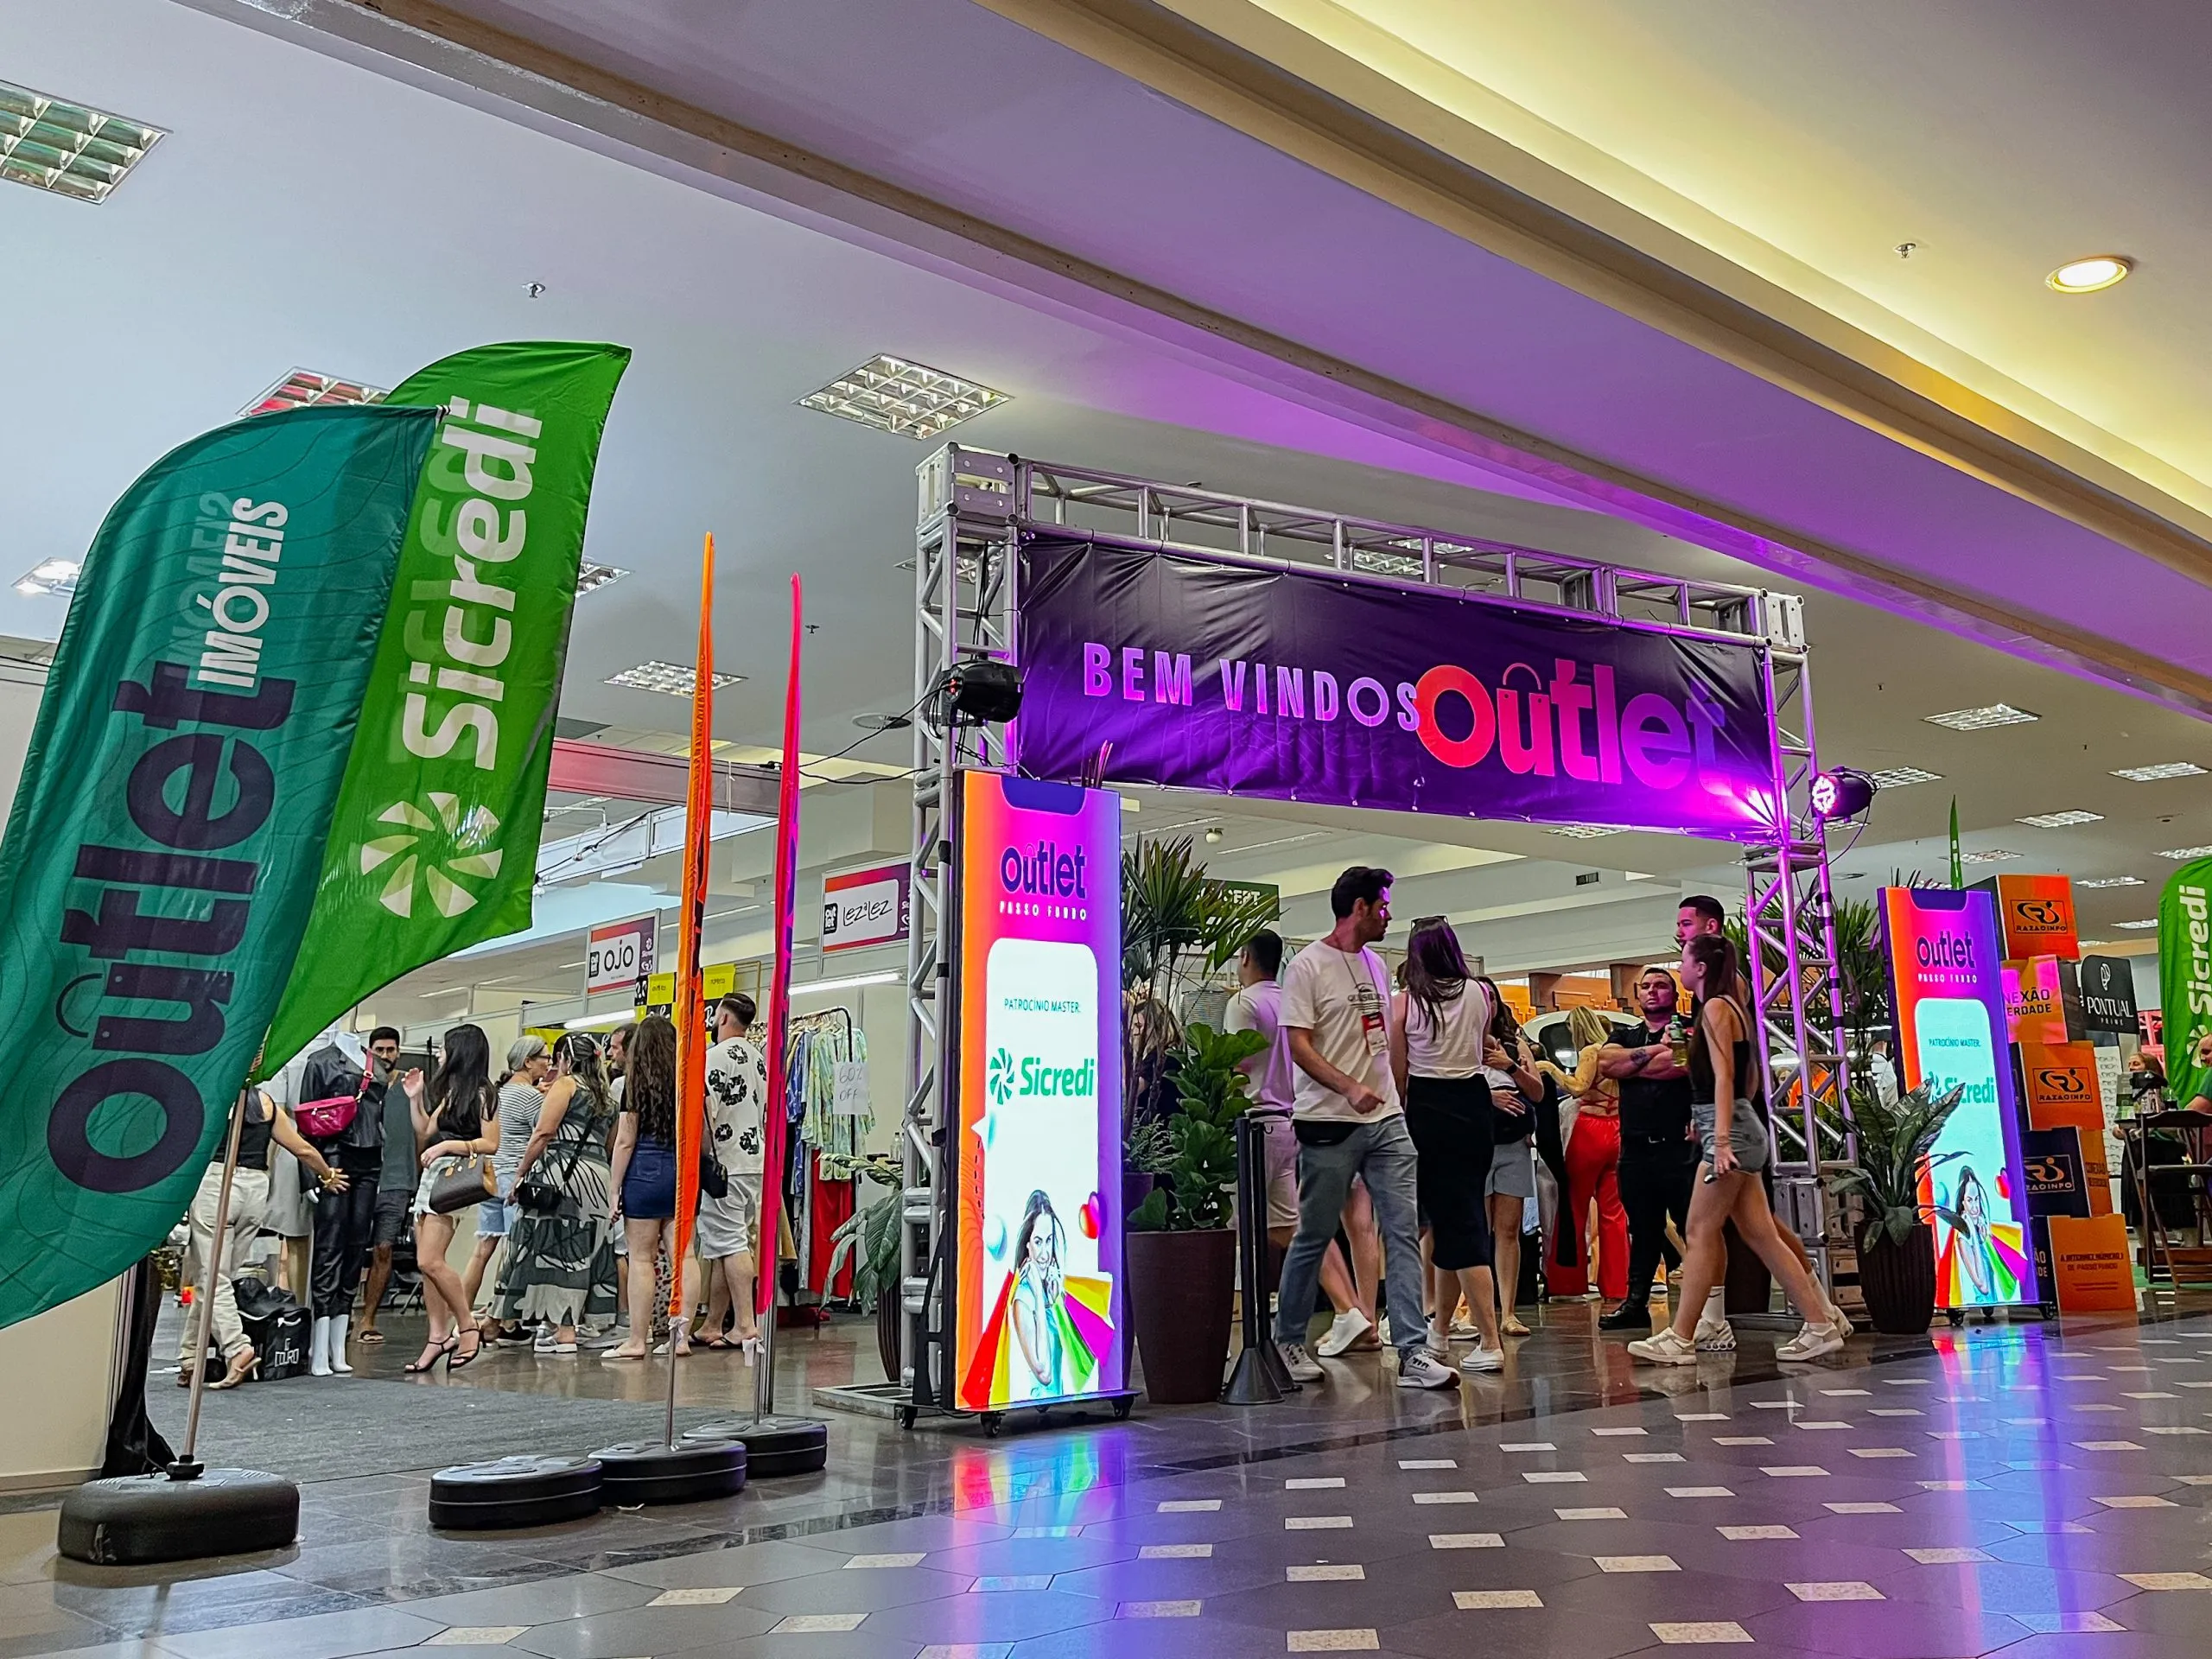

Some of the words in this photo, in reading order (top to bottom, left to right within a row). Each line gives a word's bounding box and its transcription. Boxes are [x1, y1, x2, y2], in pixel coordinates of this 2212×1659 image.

[196, 497, 289, 688] IMÓVEIS
[401, 397, 543, 772] Sicredi
[1084, 641, 1192, 706] BEM
[1218, 658, 1421, 733] VINDOS
[1414, 658, 1726, 798] Outlet
[1001, 841, 1086, 899] Outlet
[47, 660, 296, 1193] Outlet
[1916, 931, 1976, 969] Outlet
[2178, 885, 2212, 1016] Sicredi
[1004, 997, 1050, 1012] PATROCÍNIO
[2005, 987, 2050, 1003] NEXÃO
[2007, 1003, 2052, 1016] ERDADE
[2087, 996, 2134, 1018] PONTUAL
[839, 1065, 863, 1084] 60%
[1020, 1057, 1095, 1096] Sicredi
[1945, 1077, 1995, 1103] Sredi
[839, 1089, 858, 1102] OFF
[2026, 1182, 2072, 1191] ZAOINFO
